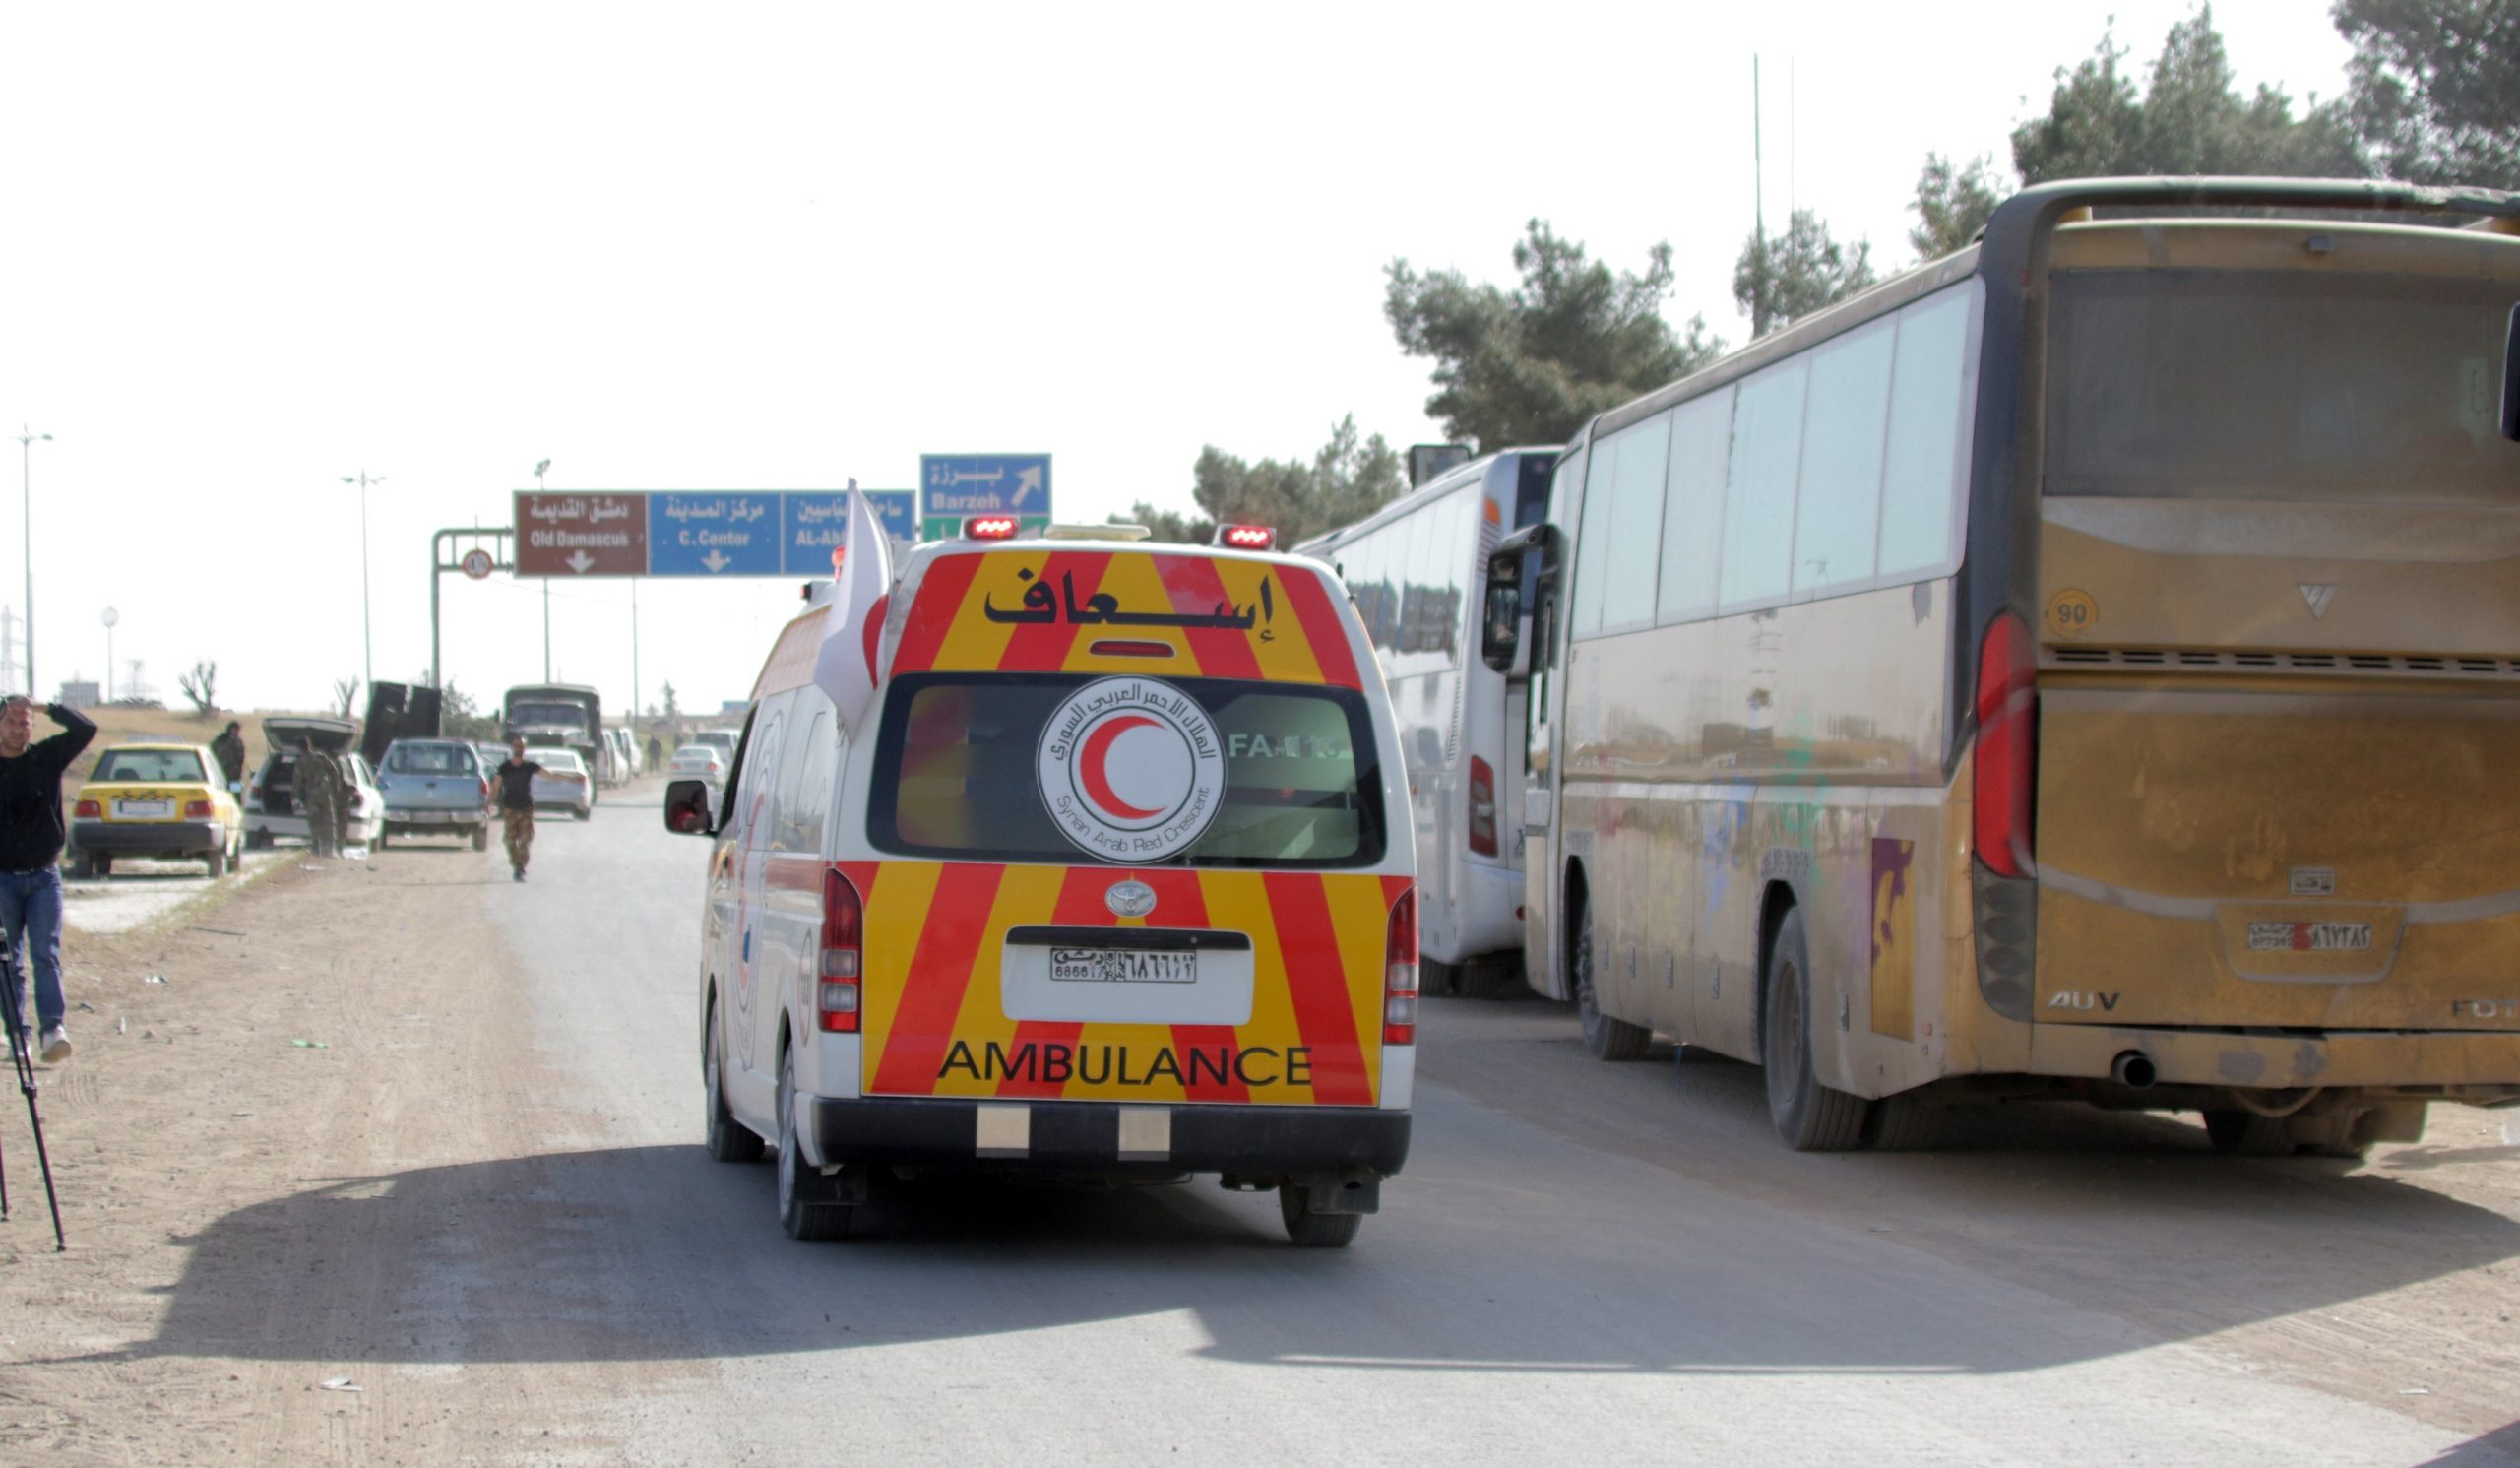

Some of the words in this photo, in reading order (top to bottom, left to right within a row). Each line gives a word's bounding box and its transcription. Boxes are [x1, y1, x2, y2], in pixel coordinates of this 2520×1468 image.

[929, 465, 1004, 485] برزة
[530, 496, 585, 524] القديمة
[590, 497, 629, 523] دمشق
[666, 495, 726, 522] المدينة
[729, 499, 764, 523] مركز
[931, 494, 1001, 510] Barzeh
[530, 530, 554, 547] Old
[556, 530, 629, 547] Damascus
[698, 530, 750, 546] Center
[984, 566, 1276, 642] إسعاف
[2057, 603, 2088, 624] 90
[1086, 683, 1142, 713] العربي
[1050, 702, 1089, 762] السوري
[1181, 715, 1218, 760] الهلال
[1056, 794, 1093, 838] Syrian
[1093, 831, 1129, 854] Arab
[1133, 834, 1164, 854] Red
[1164, 787, 1211, 844] Crescent
[2048, 990, 2121, 1012] AUV
[937, 1040, 1313, 1087] AMBULANCE
